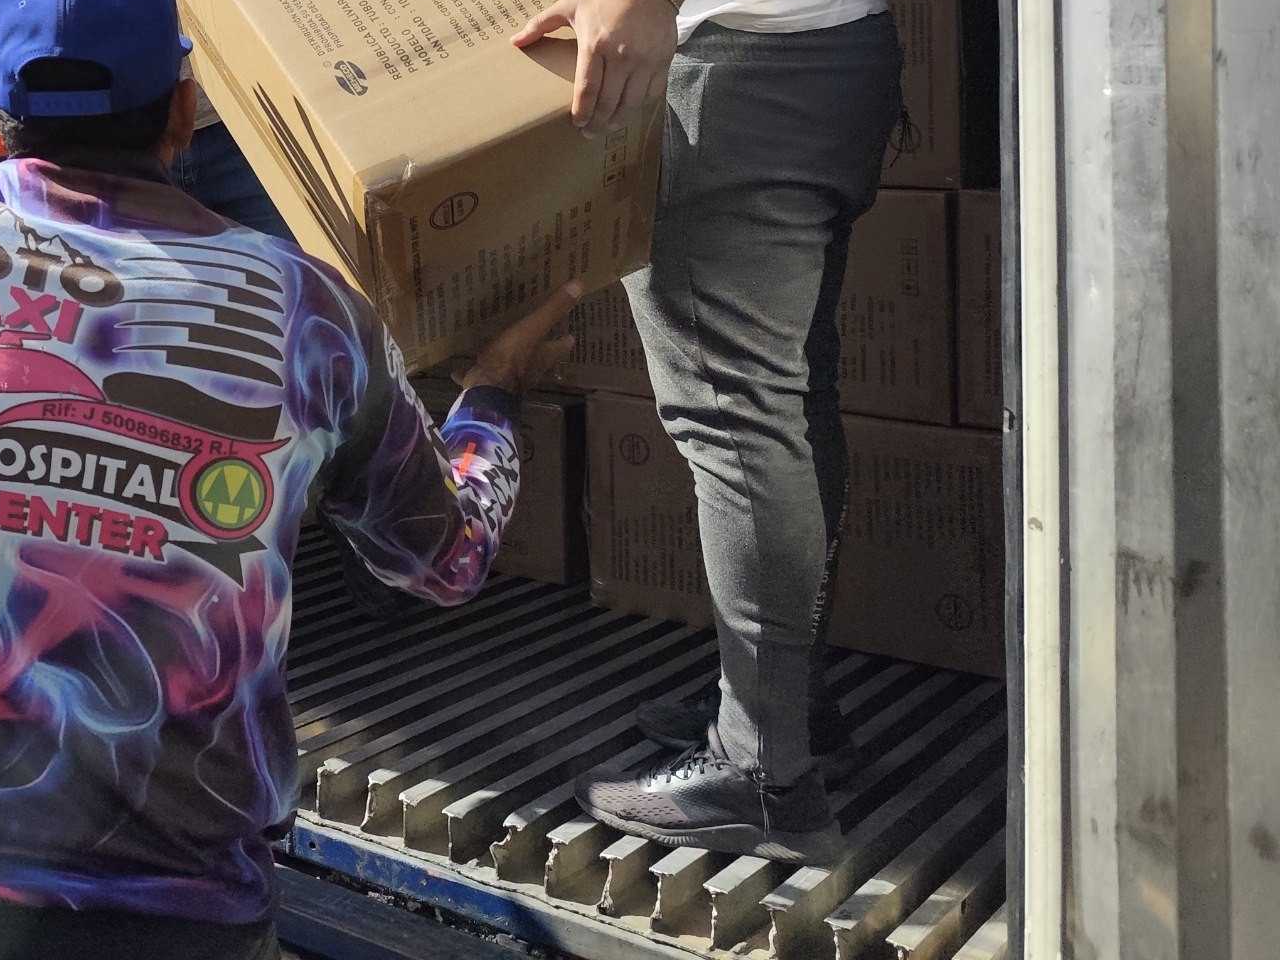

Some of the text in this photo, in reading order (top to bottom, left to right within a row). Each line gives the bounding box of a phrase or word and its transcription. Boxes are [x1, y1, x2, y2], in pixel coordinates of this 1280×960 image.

[299, 9, 310, 18] SU
[304, 0, 319, 13] DEL
[357, 0, 380, 22] TUBO
[458, 6, 490, 41] COMERCIO
[288, 12, 325, 57] DISTRIBUCIÓN
[305, 17, 335, 52] PROHIBIDA
[313, 12, 344, 48] PROPIEDAD
[399, 28, 434, 66] MODELO
[411, 15, 451, 59] CANTIDAD
[446, 16, 475, 47] DESTINO:
[359, 31, 403, 81] REPÚBLICA
[42, 404, 76, 417] Rif:
[83, 408, 95, 420] J
